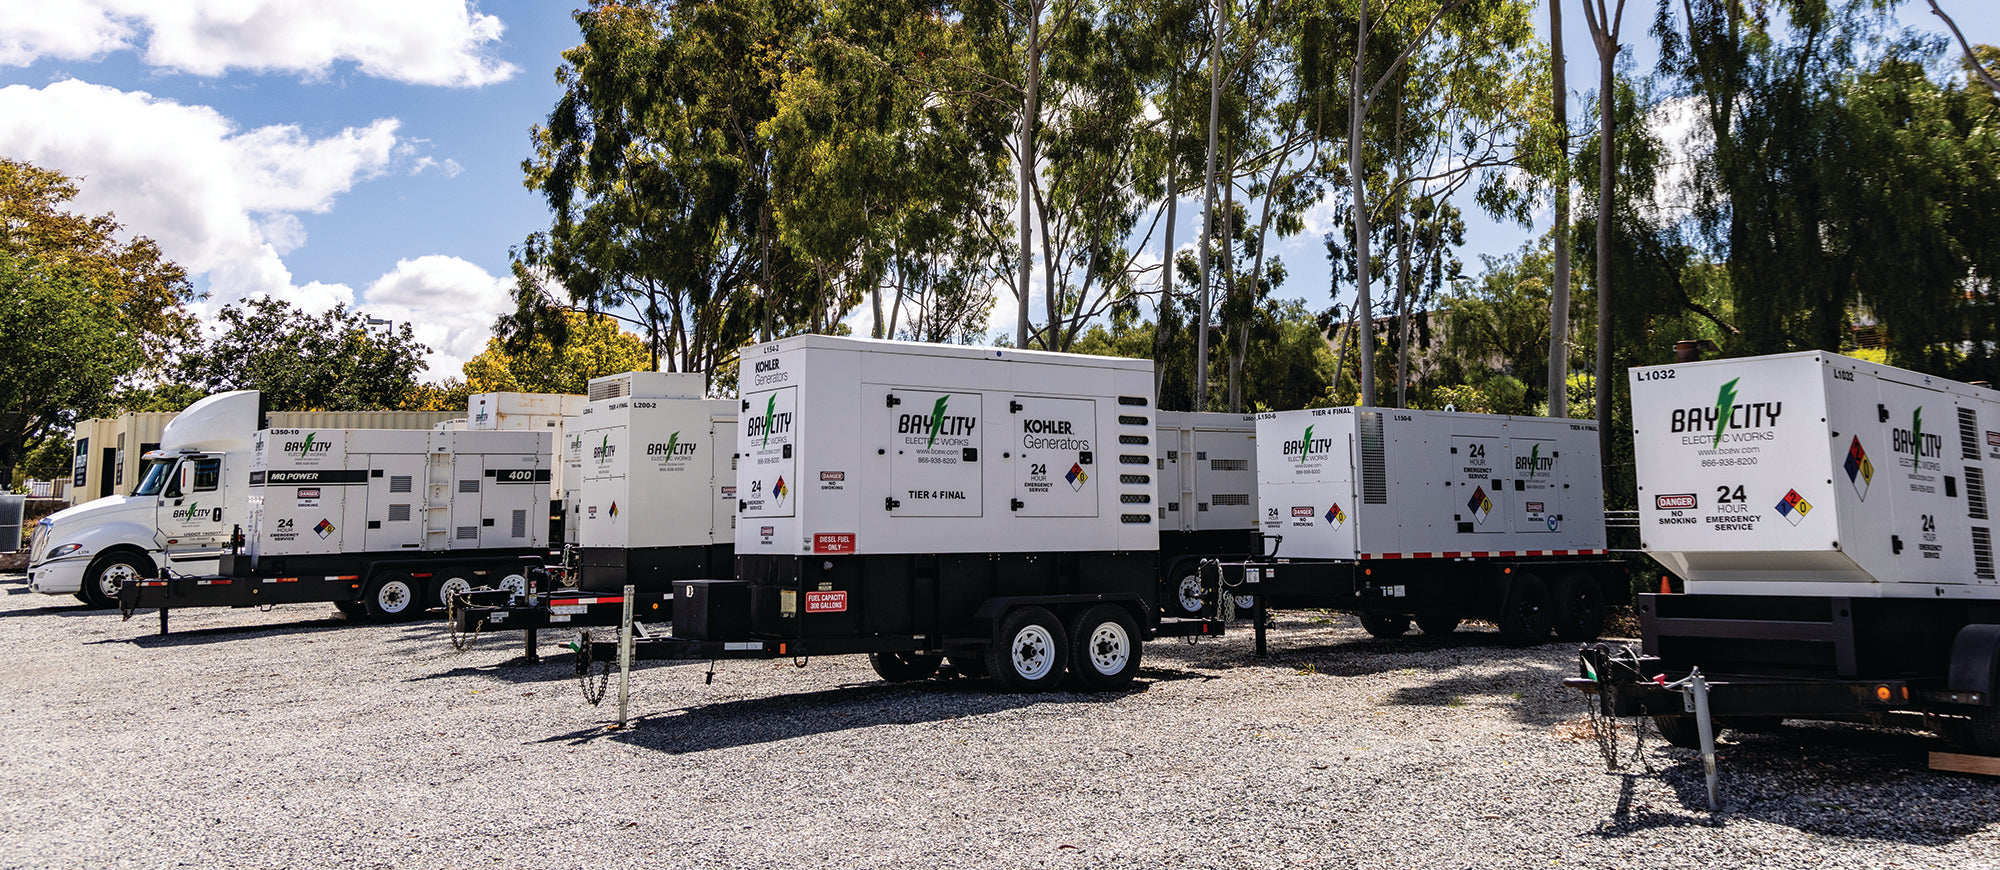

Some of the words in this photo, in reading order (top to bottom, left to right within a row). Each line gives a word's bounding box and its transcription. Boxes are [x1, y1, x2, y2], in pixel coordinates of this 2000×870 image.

[764, 345, 779, 354] L154-2
[755, 358, 779, 373] KOHLER
[755, 372, 788, 386] Generators
[1637, 370, 1676, 381] L1032
[1833, 369, 1854, 381] L1032
[1672, 406, 1719, 433] BAY
[1730, 402, 1782, 429] CITY
[748, 418, 767, 437] BAY
[770, 412, 792, 434] CITY
[898, 414, 934, 434] BAY
[940, 416, 976, 436] CITY
[1024, 420, 1072, 435] KOHLER
[905, 437, 940, 445] ELECTRIC
[1023, 434, 1090, 450] Generators
[1682, 434, 1730, 445] ELECTRIC
[1732, 431, 1774, 442] WORKS
[1893, 428, 1915, 455] BAY
[1920, 433, 1941, 458] CITY
[284, 442, 306, 452] BAY
[309, 442, 332, 452] CITY
[647, 443, 670, 455] BAY
[674, 443, 696, 455] CITY
[1283, 440, 1305, 455] BAY
[1309, 438, 1332, 454] CITY
[1470, 444, 1485, 458] 24
[1698, 447, 1760, 456] www.bcew.com
[1516, 456, 1532, 470] BAY
[1536, 458, 1553, 470] CITY
[1701, 457, 1758, 467] 866-938-8200
[1031, 464, 1046, 475] 24
[1074, 465, 1079, 474] 2
[1864, 459, 1869, 479] 0
[509, 471, 531, 480] 400
[1080, 473, 1084, 482] 0
[752, 480, 761, 492] 24
[908, 490, 929, 499] TIER
[932, 491, 937, 499] 4
[940, 491, 966, 499] FINAL
[1717, 485, 1747, 503] 24
[1790, 492, 1797, 504] 2
[1660, 498, 1693, 507] DANGER
[1781, 503, 1787, 513] 1
[1800, 502, 1806, 513] 0
[173, 510, 190, 518] BAY
[193, 509, 210, 518] CITY
[1268, 508, 1278, 516] 24
[1334, 506, 1337, 514] 2
[1718, 504, 1748, 513] HOUR
[1339, 512, 1343, 521] 0
[278, 519, 294, 528] 24
[1921, 514, 1935, 532] 24
